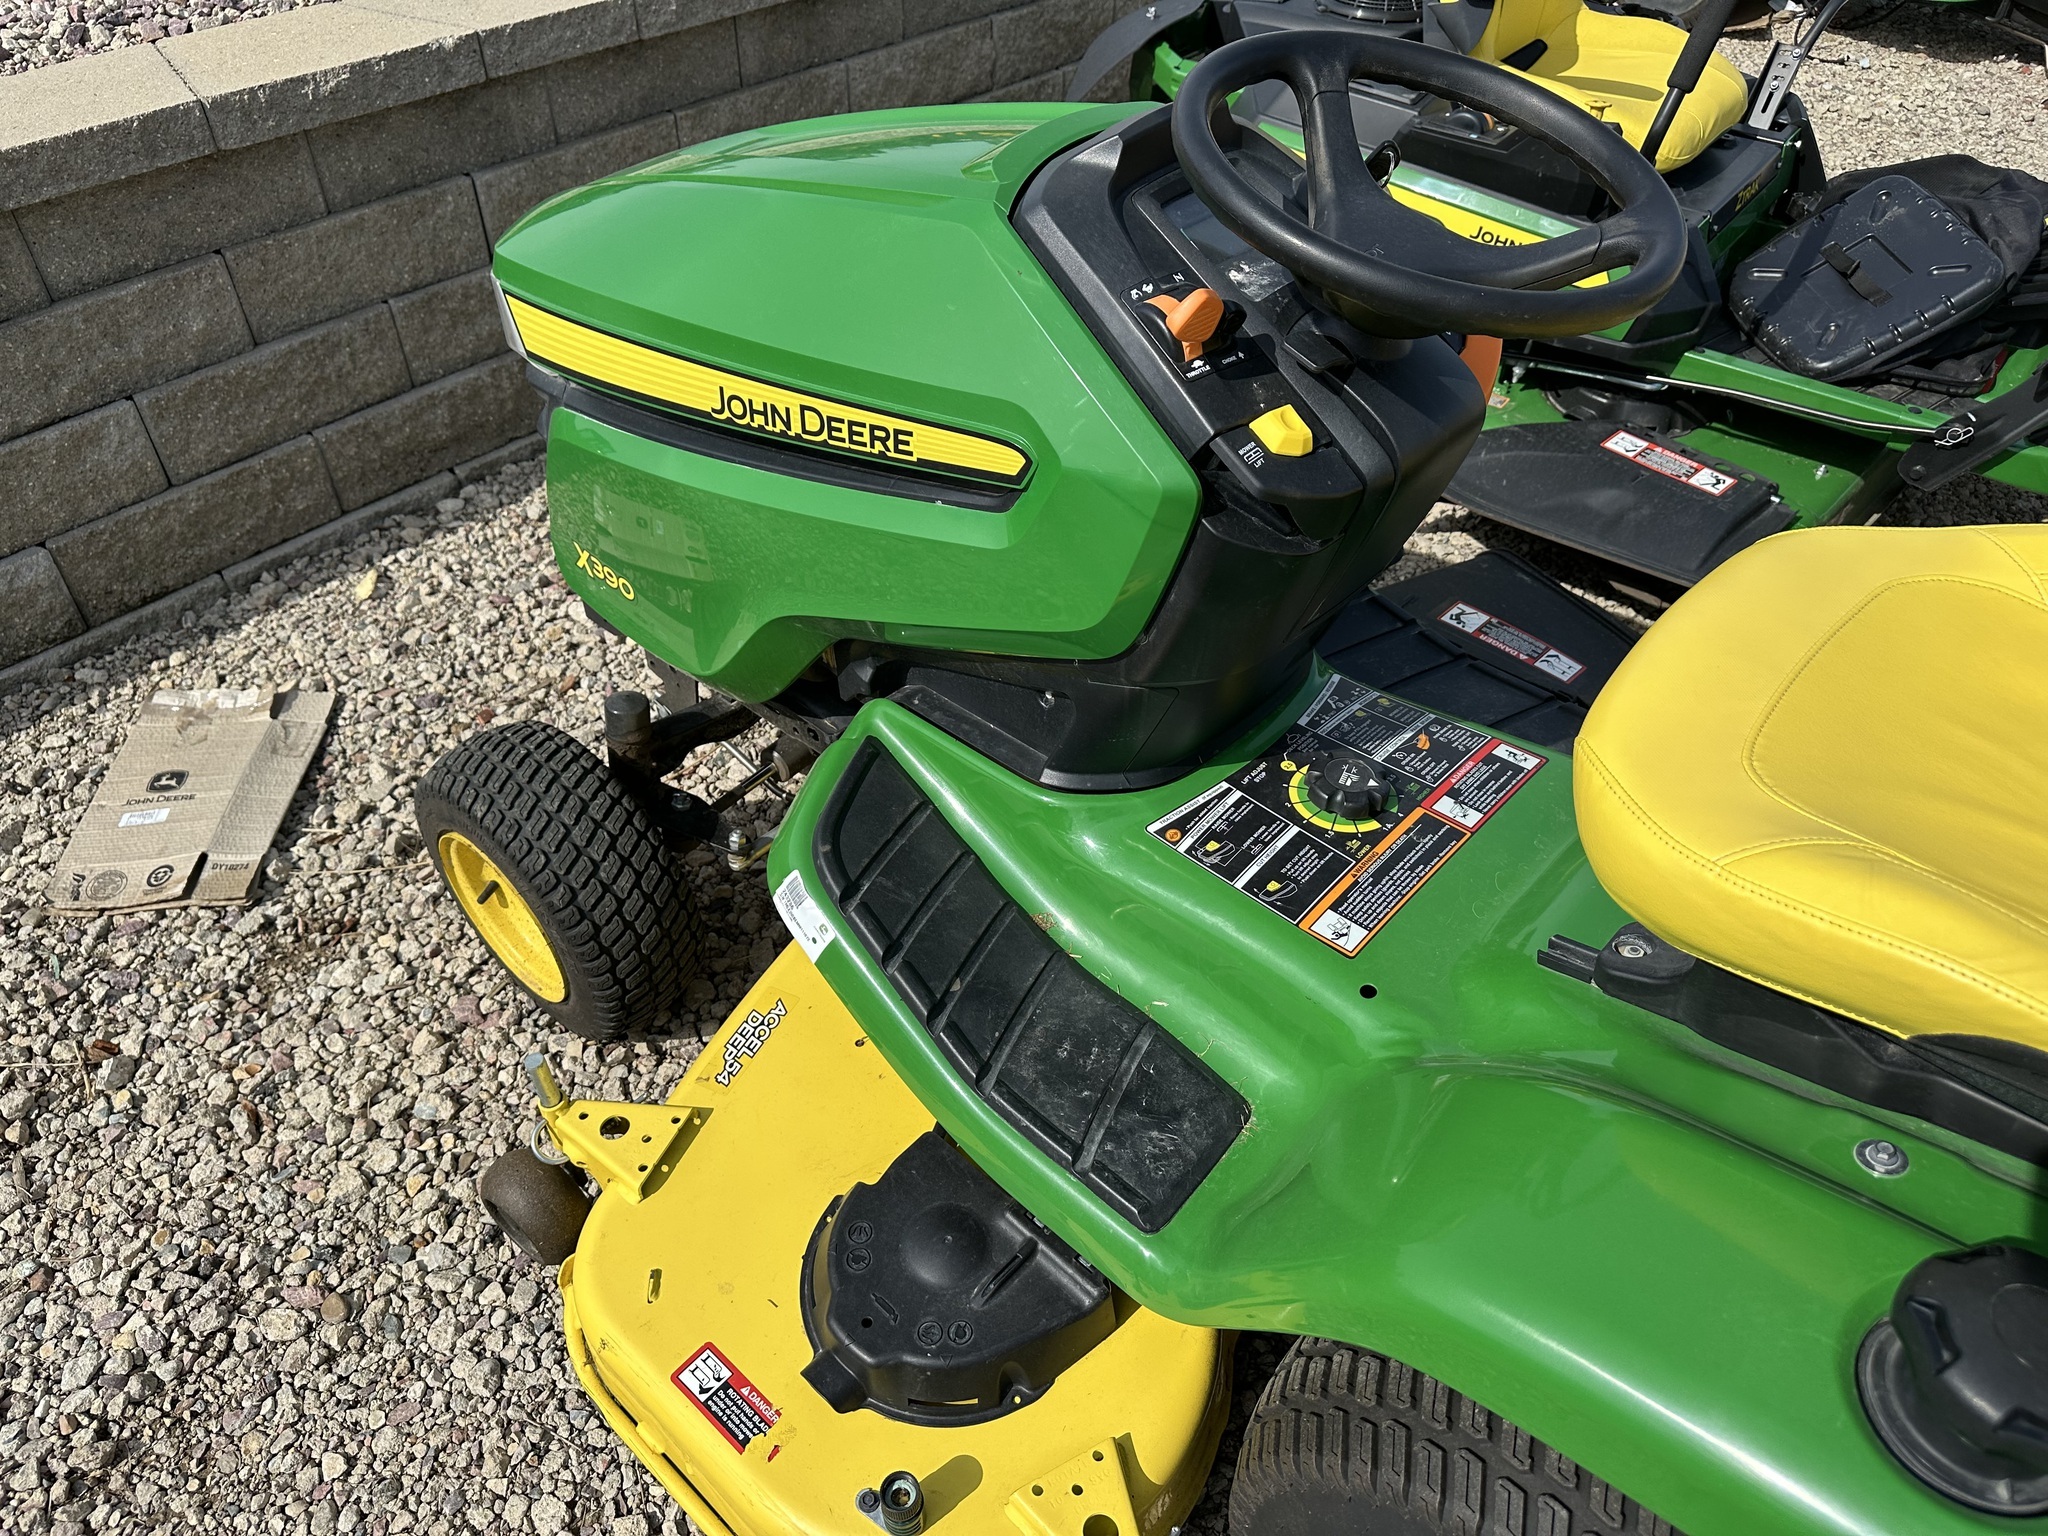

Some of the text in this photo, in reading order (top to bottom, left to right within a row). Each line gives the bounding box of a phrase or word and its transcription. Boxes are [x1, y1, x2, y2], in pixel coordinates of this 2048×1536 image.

[1186, 364, 1211, 379] THROTTLE
[711, 386, 915, 459] JOHN DEERE
[1238, 441, 1257, 455] MOWER
[1662, 449, 1699, 467] DANGER
[1253, 457, 1265, 468] LIFT
[572, 540, 635, 601] X390
[1479, 633, 1519, 656] DANGER
[1241, 762, 1267, 784] LIFT ADJUST
[1254, 772, 1266, 782] STOP
[1454, 761, 1475, 778] DANGER
[121, 793, 197, 807] JOHN DEERE
[1159, 809, 1184, 824] TRACTION
[1184, 800, 1200, 810] ASSIST
[1191, 802, 1229, 839] POWER MOWER LIFT
[1241, 825, 1266, 849] LOWER MOWER
[1256, 845, 1278, 867] CUT HEIGHT
[1354, 851, 1379, 873] WARNING
[1355, 845, 1371, 858] LOWER
[736, 998, 788, 1059] ACCEL
[715, 1009, 765, 1087] DEEP 54
[713, 1395, 726, 1409] under
[730, 1413, 740, 1424] into
[717, 1390, 725, 1398] Do
[724, 1398, 733, 1407] not
[730, 1405, 741, 1415] put
[739, 1413, 754, 1429] hands
[727, 1388, 754, 1417] ROTATING
[749, 1392, 779, 1423] DANGER
[708, 1400, 723, 1416] engine
[726, 1420, 744, 1440] running
